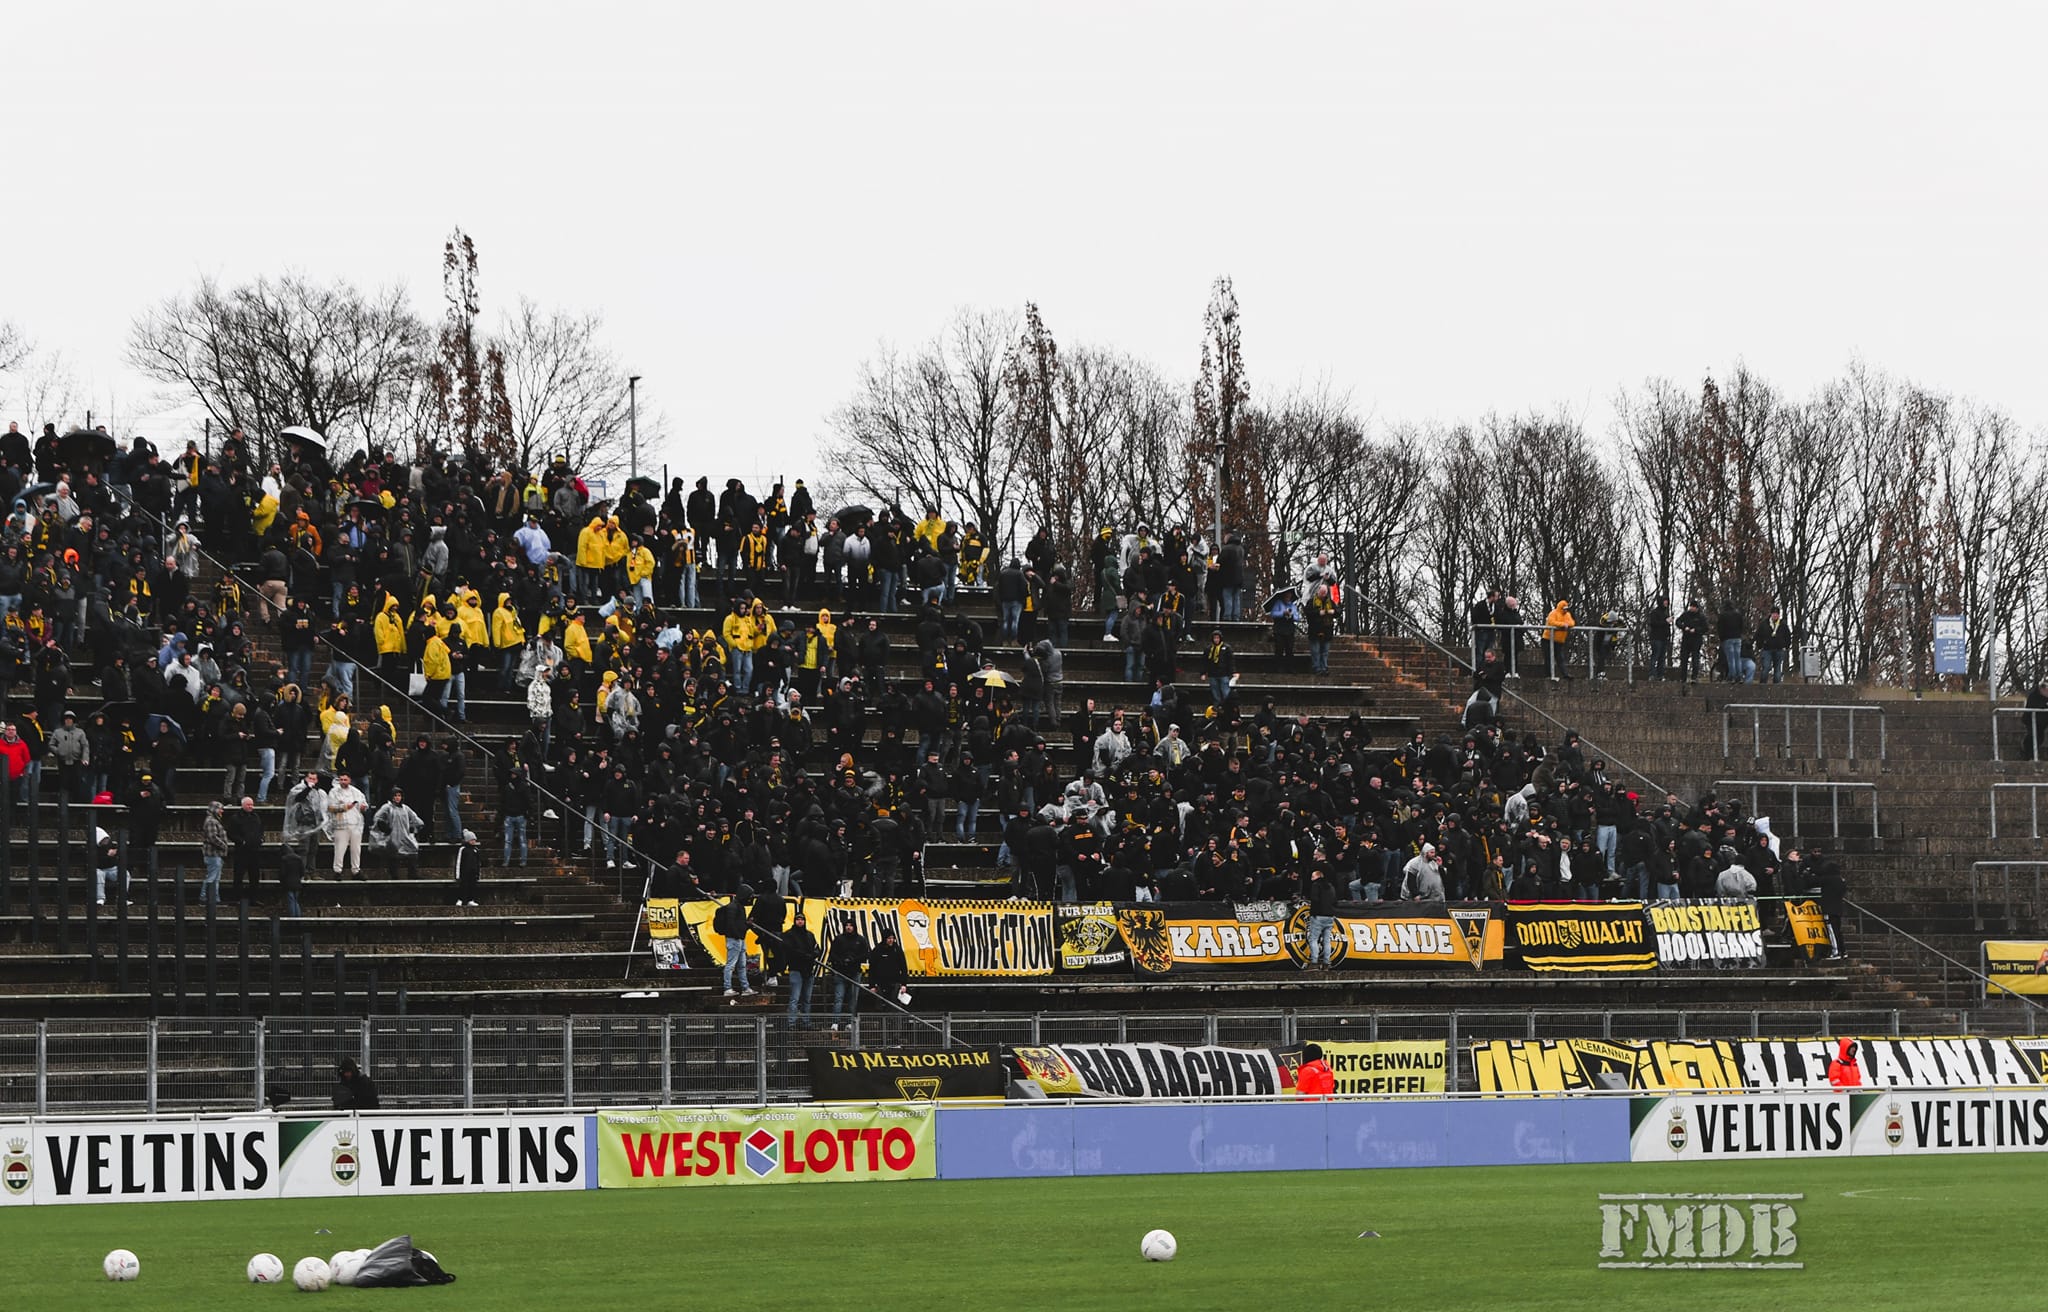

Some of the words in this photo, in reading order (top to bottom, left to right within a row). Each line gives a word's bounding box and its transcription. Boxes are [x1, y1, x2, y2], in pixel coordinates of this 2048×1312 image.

[1059, 904, 1080, 916] FÜR
[1082, 905, 1114, 916] STADT
[1651, 905, 1760, 933] BOXSTAFFEL
[937, 912, 1054, 969] CONNECTION
[1168, 925, 1280, 957] KARLS
[1350, 923, 1454, 954] BANDE
[1066, 956, 1086, 966] UND
[1087, 951, 1125, 965] VEREIN
[1992, 963, 2011, 971] Tivoli
[2013, 963, 2035, 973] Tigers
[1324, 1050, 1443, 1072] ÜRTGENWALD
[1574, 1039, 1631, 1061] ALEMANNIA
[1067, 1048, 1145, 1097] BAD
[1136, 1048, 1275, 1098] AACHEN
[1696, 1102, 1843, 1152] VELTINS
[1911, 1099, 2048, 1147] VELTINS
[45, 1131, 268, 1195] VELTINS
[371, 1126, 579, 1186] VELTINS
[621, 1131, 742, 1177] WEST
[784, 1127, 916, 1173] LOTTO
